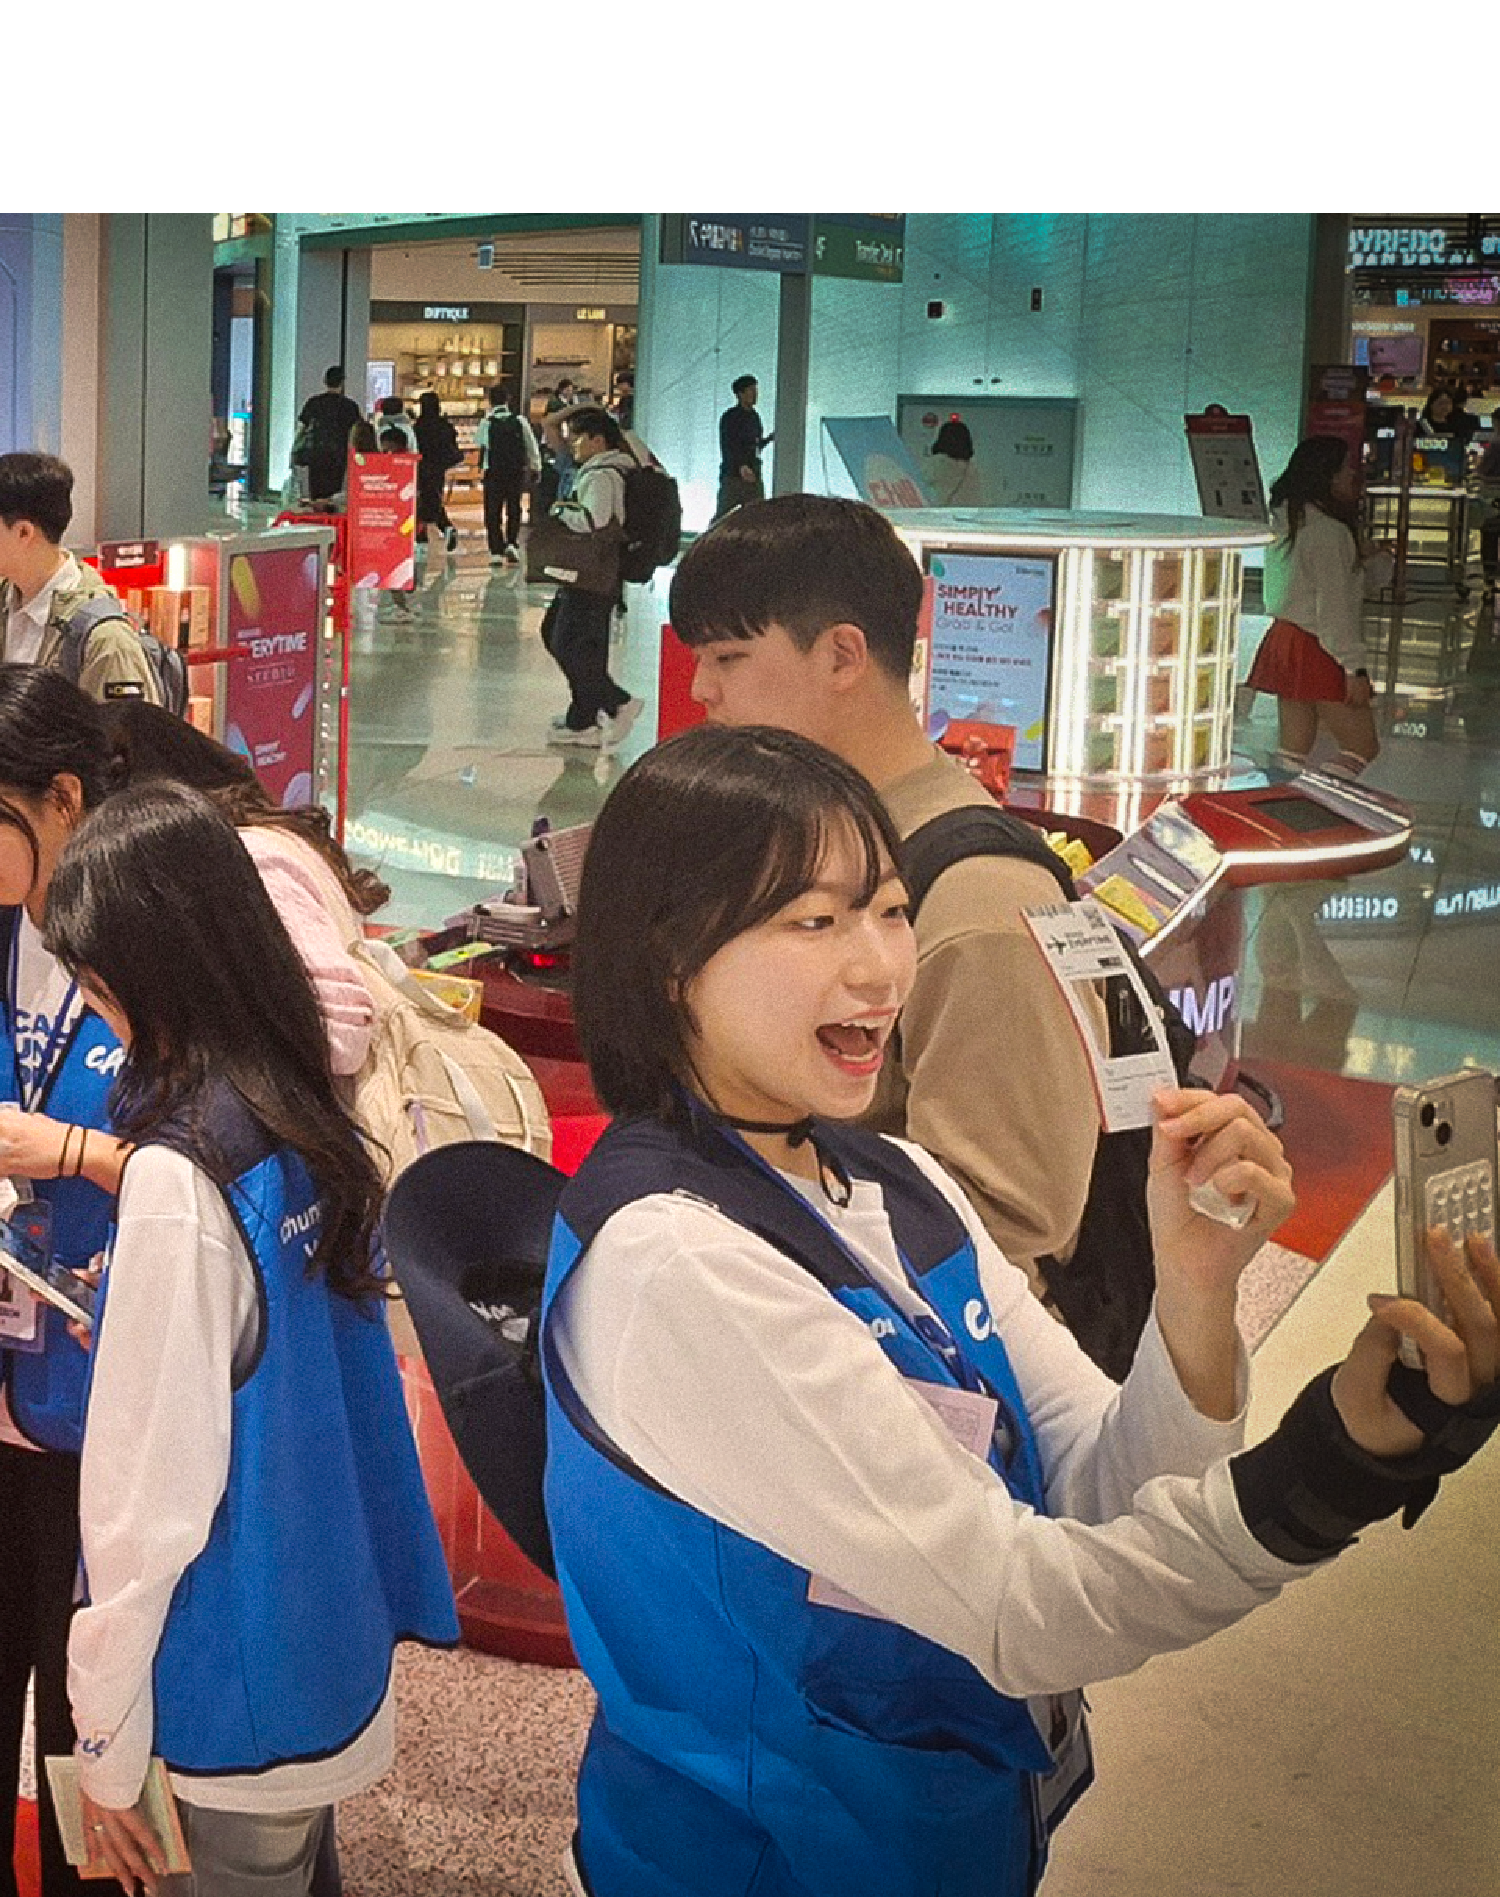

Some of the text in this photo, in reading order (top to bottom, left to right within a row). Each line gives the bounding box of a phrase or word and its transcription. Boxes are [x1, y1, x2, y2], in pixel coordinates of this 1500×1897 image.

[944, 601, 1018, 620] HEALTHY
[84, 1047, 127, 1077] CA
[280, 1201, 326, 1245] chun
